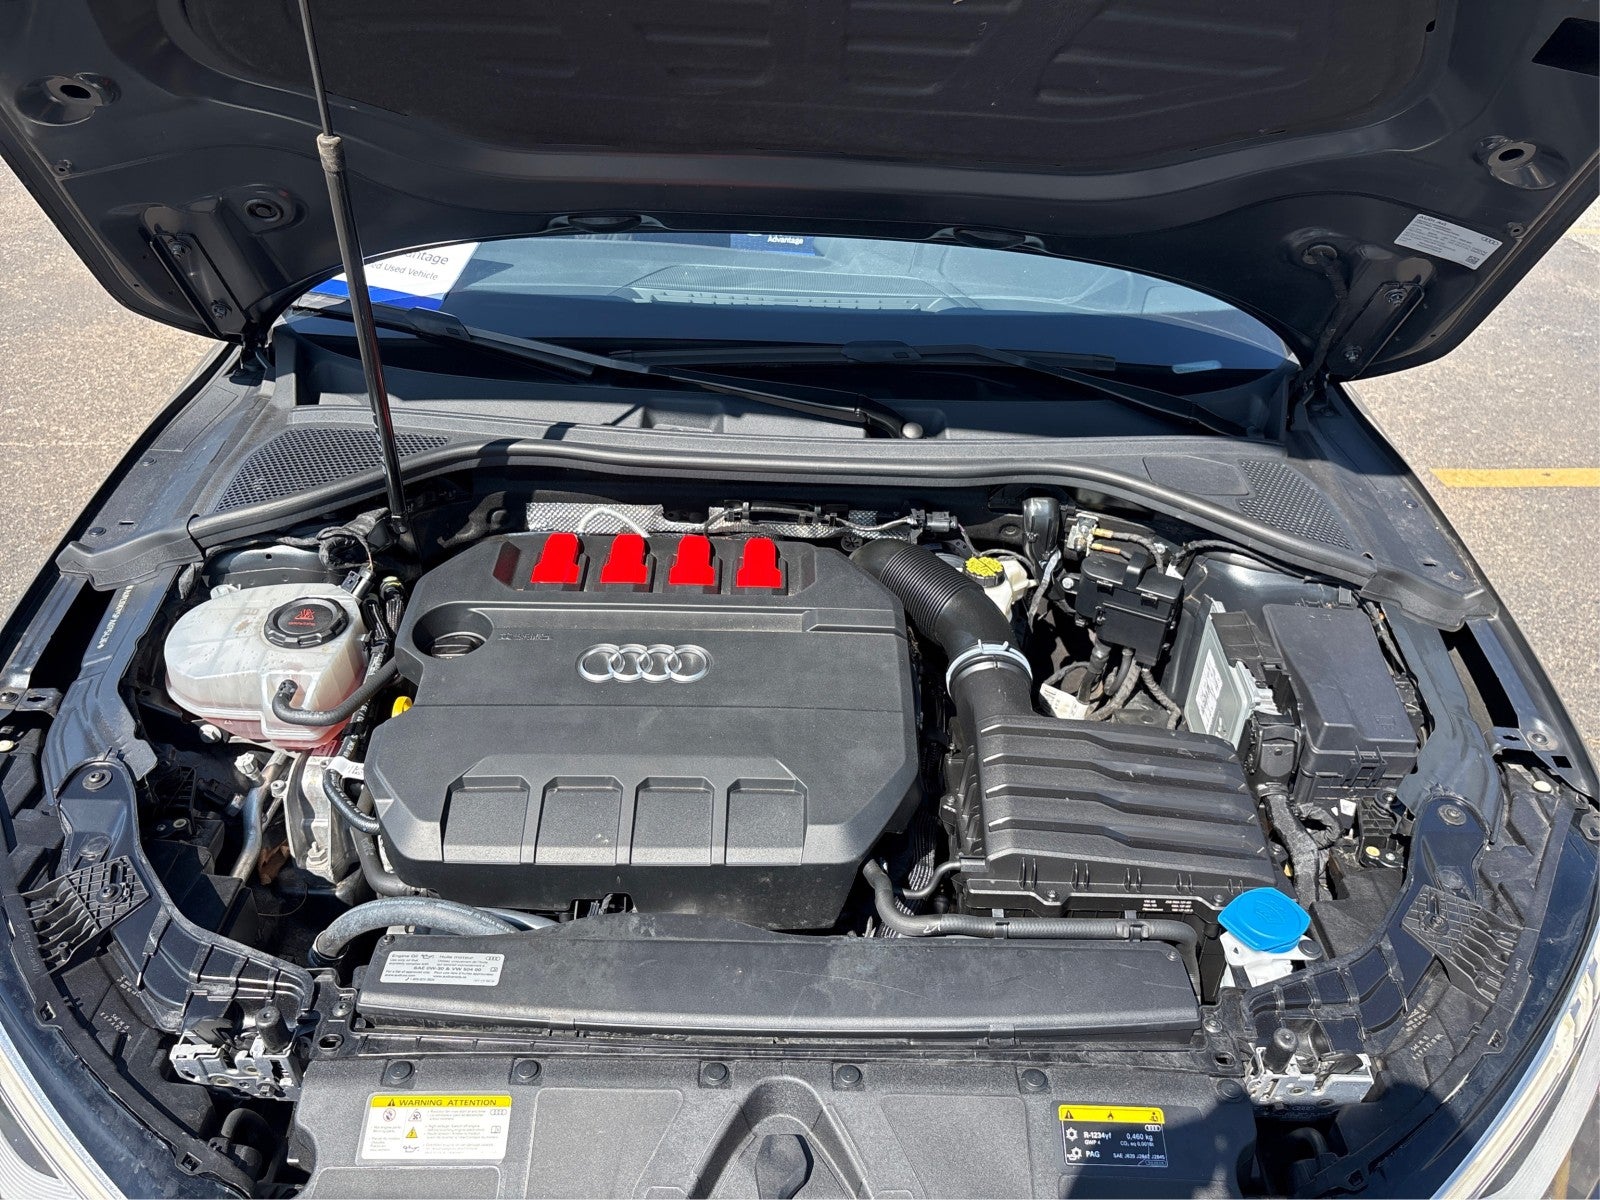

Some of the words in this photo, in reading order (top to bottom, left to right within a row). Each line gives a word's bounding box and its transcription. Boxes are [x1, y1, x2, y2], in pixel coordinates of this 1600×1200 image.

[767, 235, 804, 245] Advantage
[404, 251, 449, 265] antage
[384, 263, 407, 274] Used
[408, 268, 439, 281] Vehicle
[1083, 1131, 1112, 1140] R-1234yf
[1144, 1133, 1153, 1141] kg
[1085, 1150, 1100, 1158] PAG
